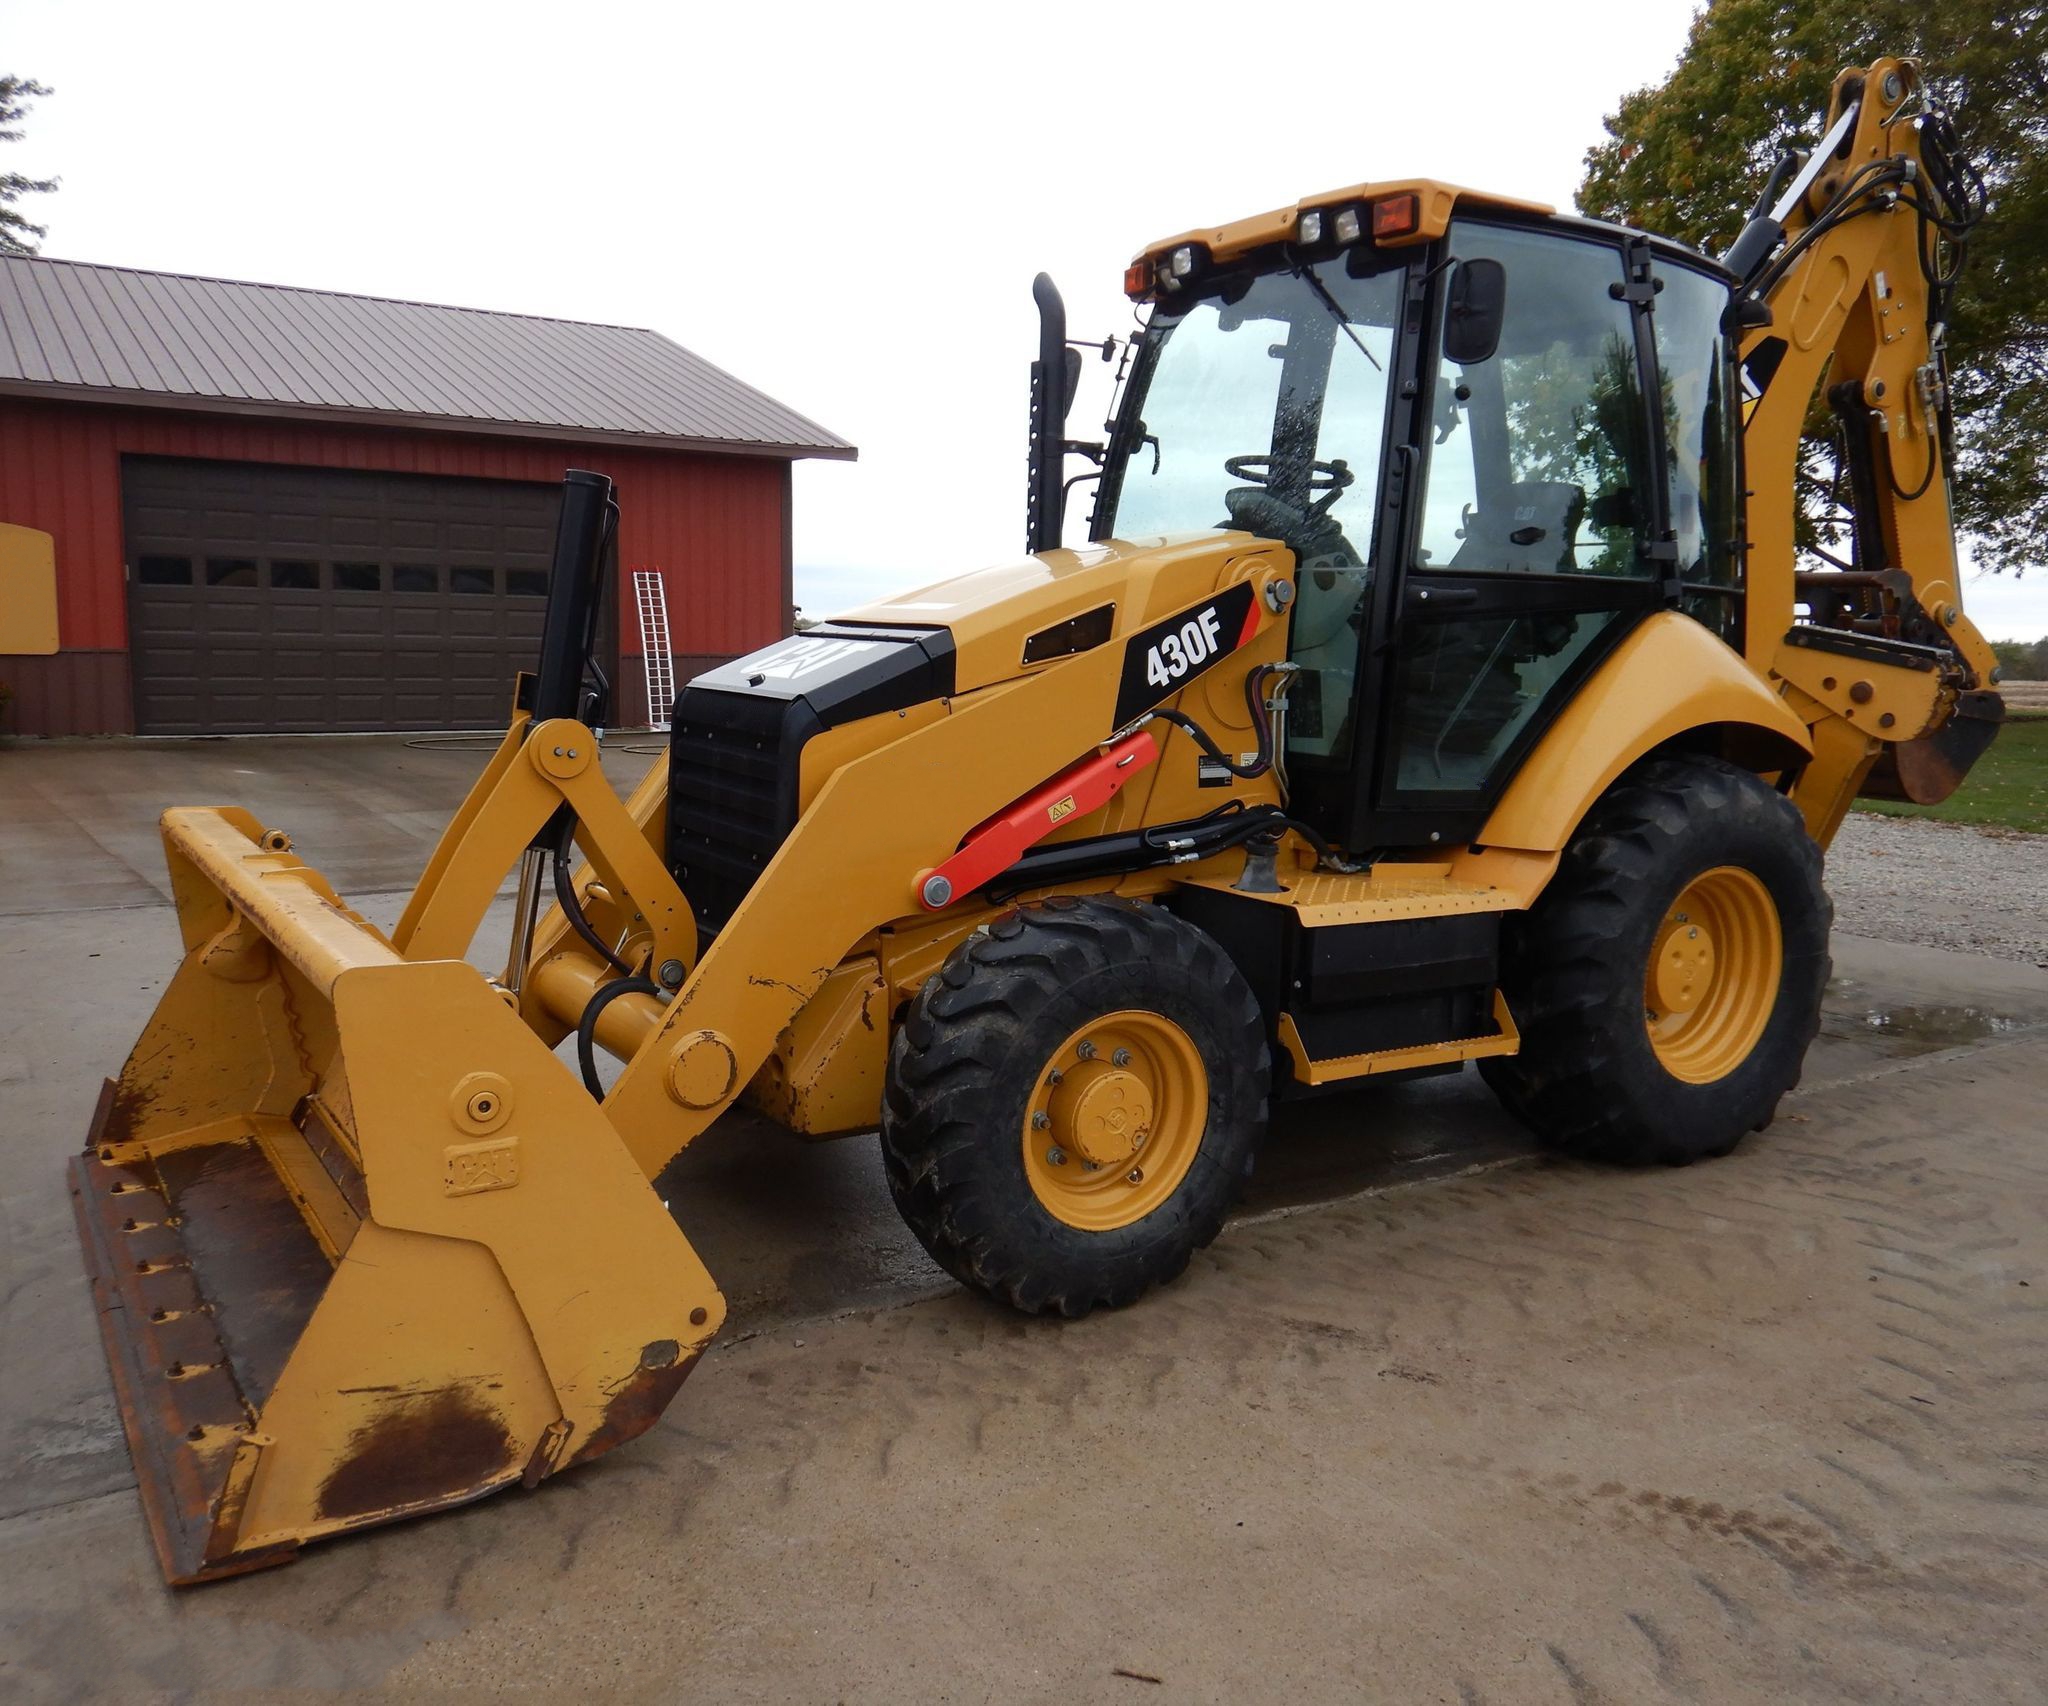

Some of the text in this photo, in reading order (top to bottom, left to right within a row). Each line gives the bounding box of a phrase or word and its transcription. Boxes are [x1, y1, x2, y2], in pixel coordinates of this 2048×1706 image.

[740, 637, 880, 680] CAT
[1146, 606, 1221, 687] 430F
[453, 1147, 515, 1190] CAT
